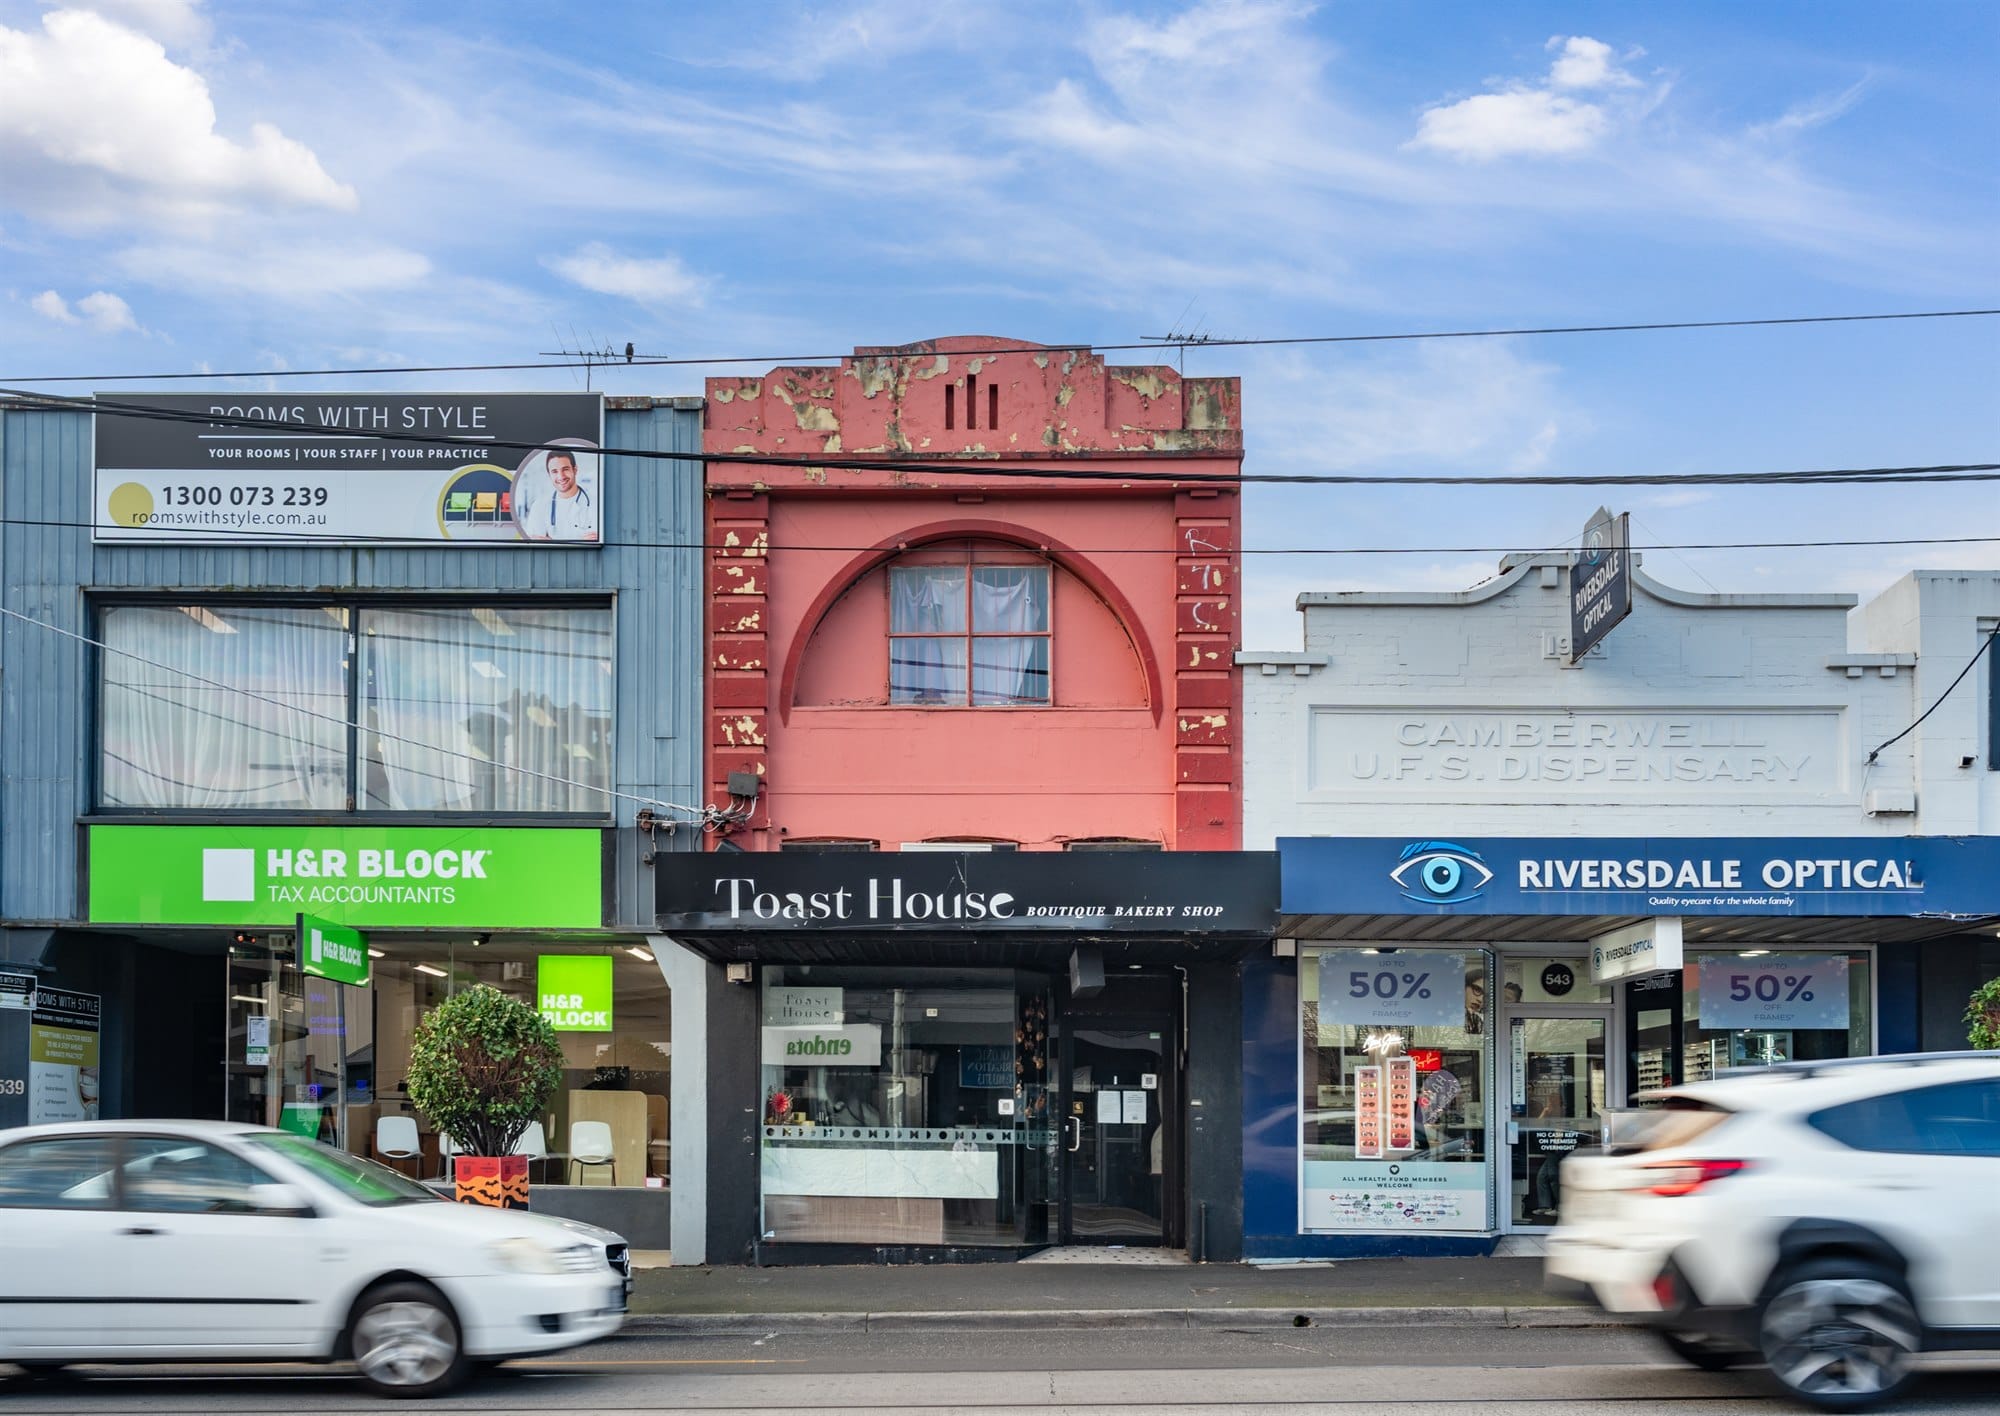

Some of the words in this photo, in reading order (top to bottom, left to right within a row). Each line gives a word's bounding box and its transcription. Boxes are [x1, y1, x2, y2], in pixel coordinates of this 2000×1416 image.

[318, 407, 389, 429] WITH
[402, 407, 487, 429] STYLE
[209, 448, 242, 459] YOUR
[246, 448, 291, 459] ROOMS
[303, 448, 337, 459] YOUR
[340, 448, 378, 459] STAFF
[390, 448, 424, 459] YOUR
[428, 448, 489, 459] PRACTICE
[162, 486, 222, 506] 1300
[229, 487, 275, 506] 073
[282, 487, 329, 507] 239
[132, 510, 327, 528] roomswithstyle.com.au
[1575, 551, 1620, 614] RIVERSDALE
[1583, 591, 1613, 635] OPTICAL
[1395, 719, 1768, 748] CAMBERWELL
[1350, 753, 1485, 781] U.F.S.
[1498, 754, 1812, 782] DISPENSARY
[266, 848, 347, 878] H&R
[1519, 859, 1742, 889] RIVERSDALE
[1761, 859, 1926, 889] OPTICAL
[268, 885, 304, 903] TAX
[308, 886, 456, 904] ACCOUNTANTS
[714, 878, 853, 920] Toast
[869, 877, 1015, 920] House
[1648, 896, 1680, 908] Quality
[1681, 899, 1711, 908] eyecare
[1713, 896, 1726, 906] for
[1727, 896, 1740, 906] the
[1742, 896, 1767, 906] whole
[1768, 896, 1796, 908] family
[1026, 905, 1106, 918] BOUTIQUE
[1113, 905, 1176, 917] BAKERY
[1181, 905, 1225, 917] SHOP
[322, 941, 338, 960] H&R
[339, 945, 363, 967] BLOCK
[1605, 944, 1633, 961] RIVERSDALE
[1632, 938, 1654, 954] OPTICAL
[1378, 960, 1393, 968] UP
[1395, 960, 1406, 968] TO
[1759, 962, 1774, 970] UP
[1775, 962, 1788, 970] TO
[1349, 971, 1432, 999] 50%
[1545, 974, 1571, 985] 543
[1729, 974, 1815, 1002] 50%
[37, 991, 57, 1006] OOMS
[58, 994, 77, 1009] WITH
[77, 998, 99, 1013] STYLE
[541, 993, 583, 1010] H&R
[1382, 1001, 1399, 1009] OFF
[1763, 1003, 1783, 1011] OFF
[542, 1010, 608, 1027] BLOCK
[782, 1006, 831, 1019] House
